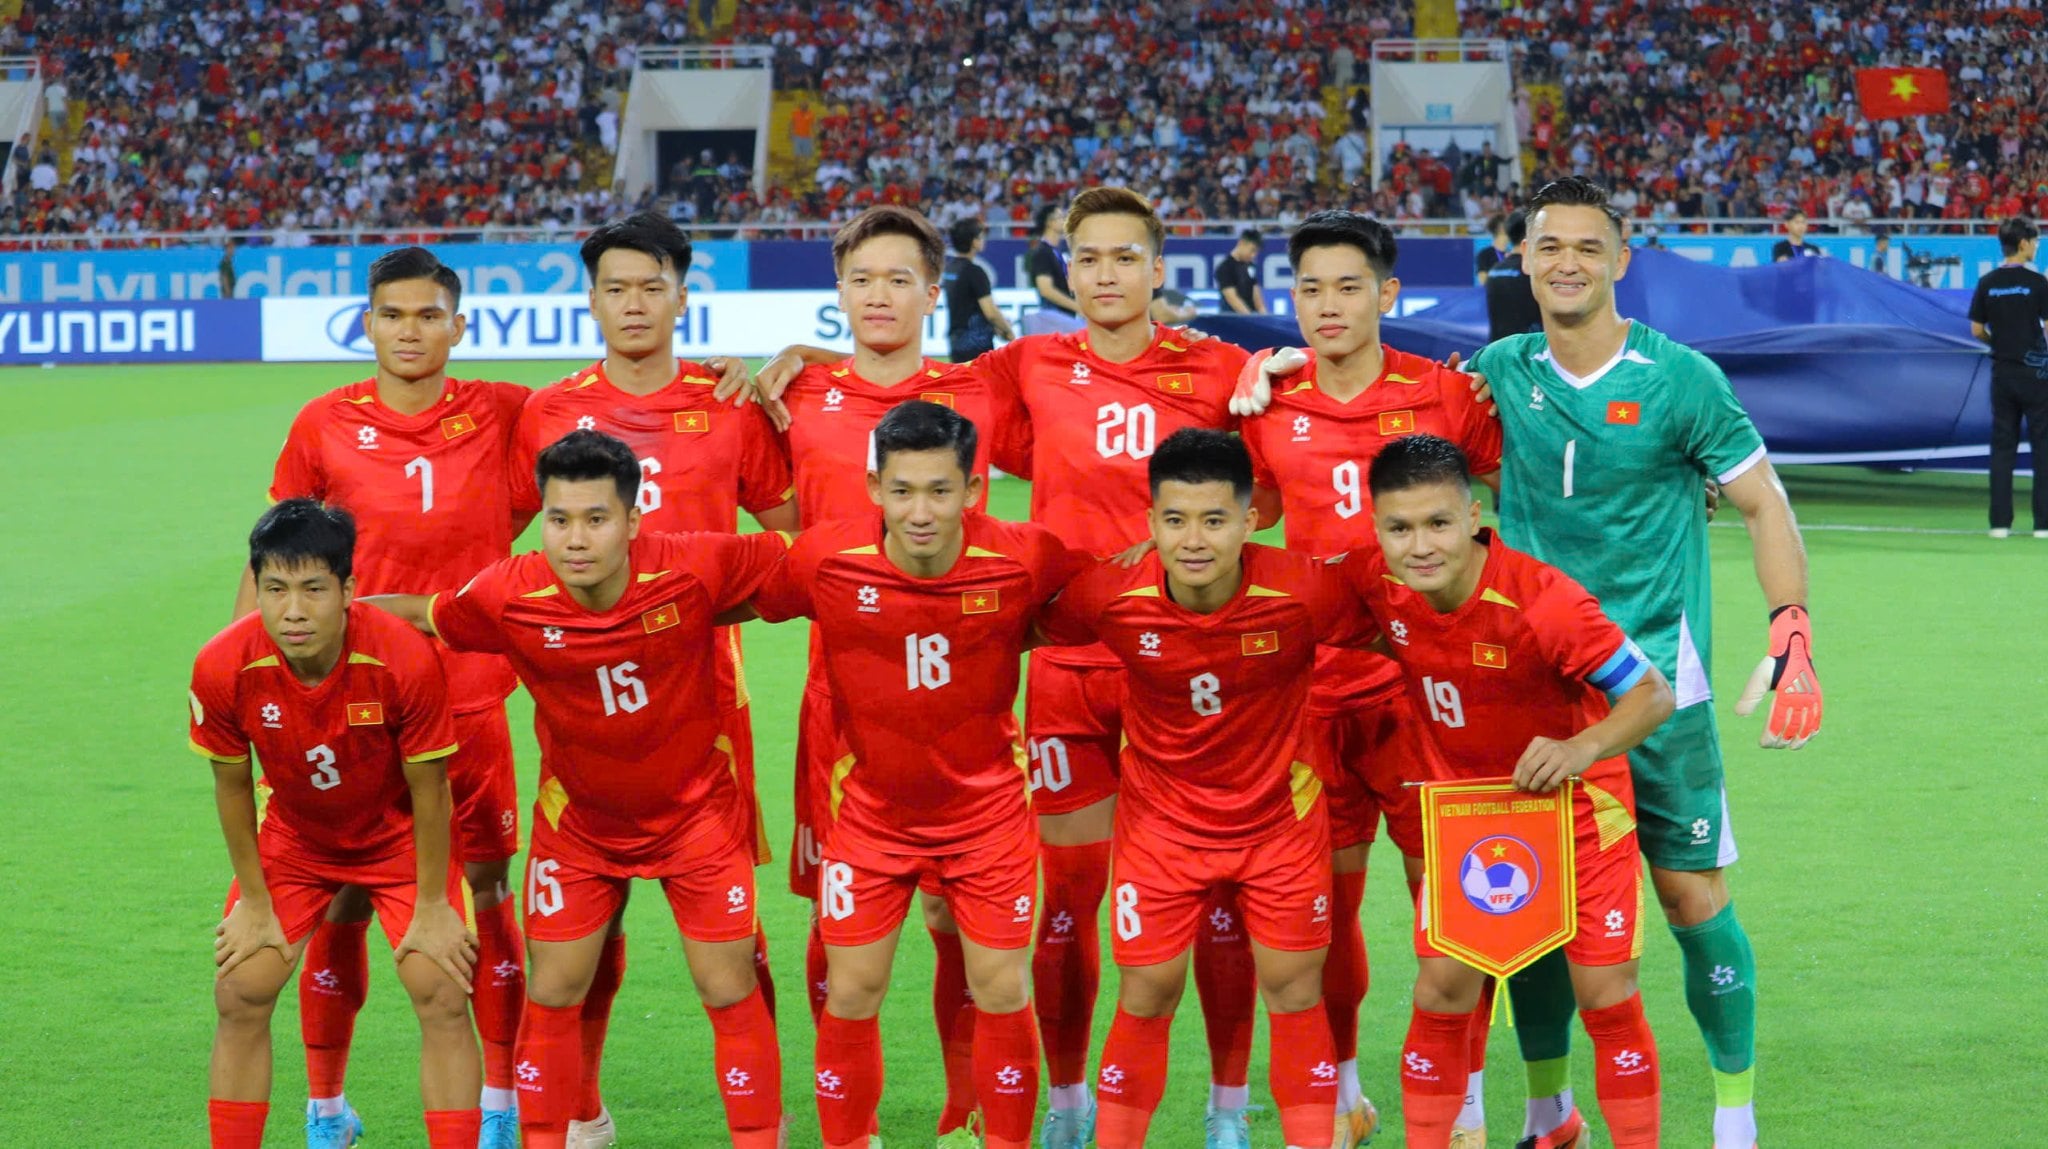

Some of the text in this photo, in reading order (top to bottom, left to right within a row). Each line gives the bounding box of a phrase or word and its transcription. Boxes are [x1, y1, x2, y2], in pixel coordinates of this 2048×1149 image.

[42, 252, 350, 301] Hyundai
[1096, 402, 1155, 460] 20
[404, 456, 433, 513] 7
[635, 457, 661, 515] 6
[1332, 460, 1361, 519] 9
[1563, 439, 1575, 498] 1
[596, 660, 649, 716] 15
[905, 633, 950, 690] 18
[1190, 672, 1221, 716] 8
[1422, 676, 1465, 728] 19
[306, 744, 341, 790] 3
[1440, 799, 1555, 817] VIETNAM FOOTBALL FEDERATION
[528, 857, 564, 917] 15
[822, 860, 855, 921] 18
[1116, 882, 1142, 942] 8
[1490, 893, 1513, 904] VFF
